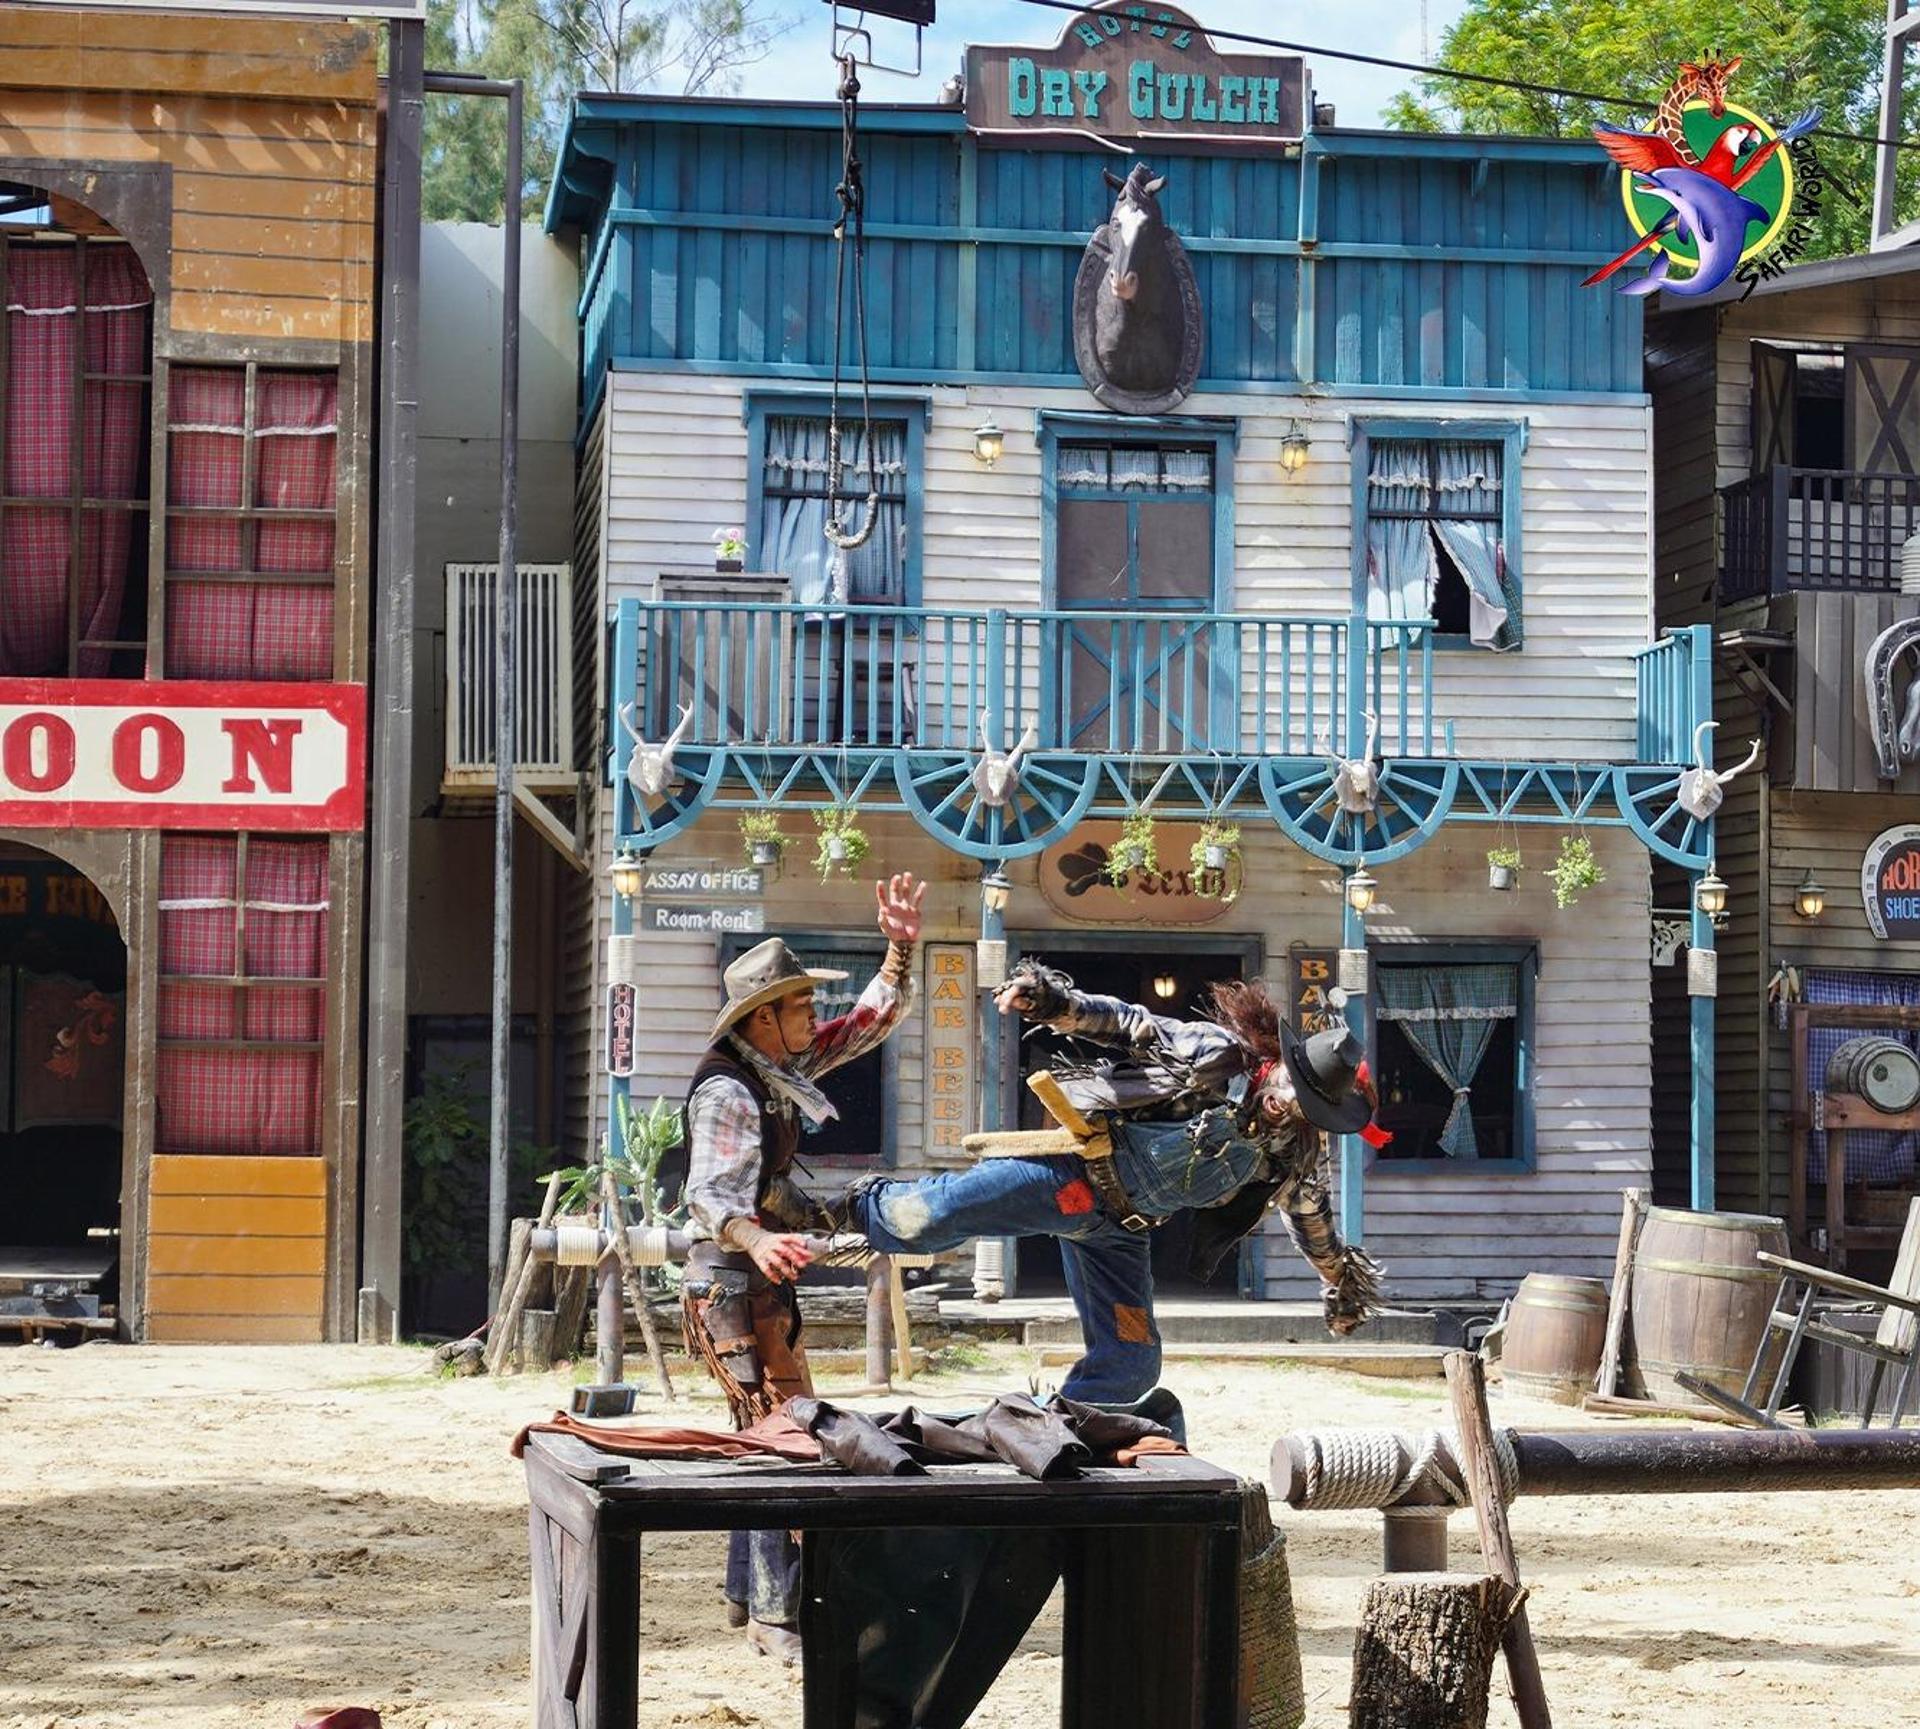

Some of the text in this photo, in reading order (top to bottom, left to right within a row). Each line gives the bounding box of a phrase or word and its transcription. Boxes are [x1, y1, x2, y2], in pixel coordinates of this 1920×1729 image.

[1073, 6, 1191, 48] HOTEL
[1009, 57, 1280, 124] DRY GULCH
[645, 871, 759, 890] ASSAY OFFICE
[656, 908, 753, 930] Room Rent
[614, 984, 632, 1073] HOTEL
[932, 953, 967, 1147] BAR BEER
